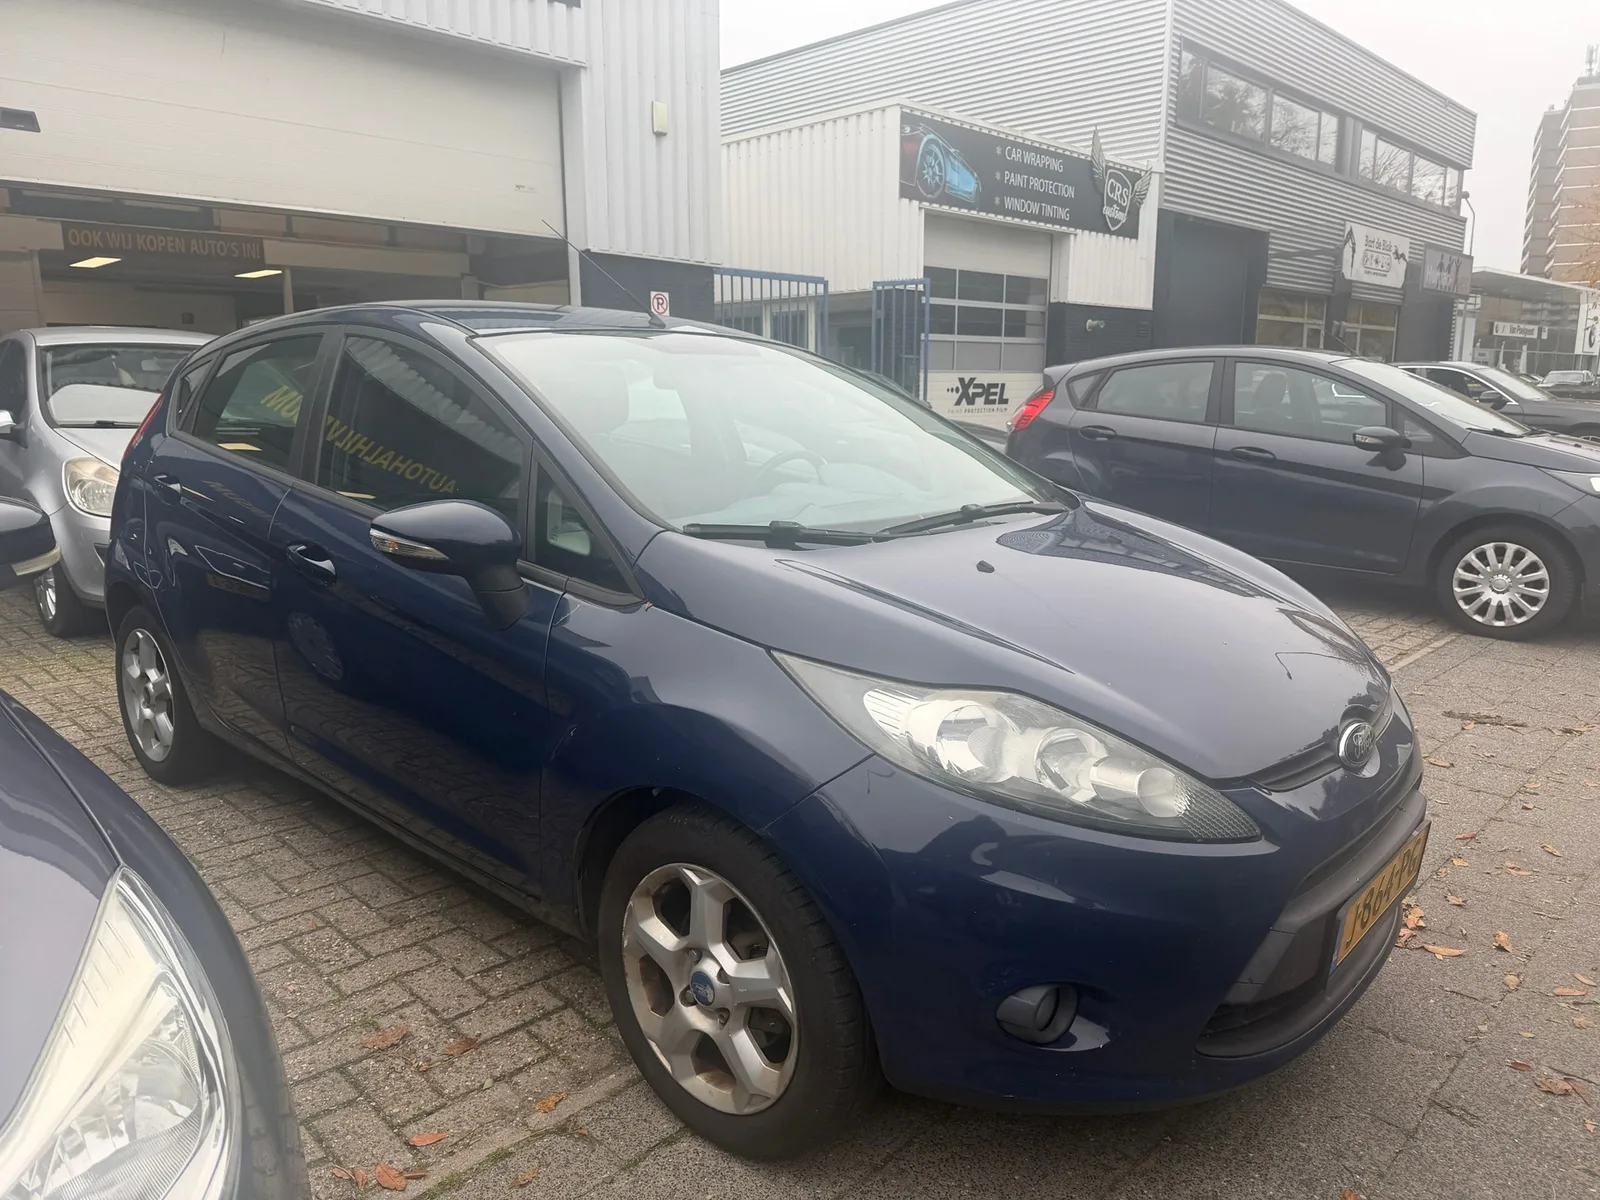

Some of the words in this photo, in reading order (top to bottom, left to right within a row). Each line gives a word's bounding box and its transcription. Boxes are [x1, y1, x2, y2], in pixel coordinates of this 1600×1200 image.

[1005, 146, 1022, 162] CAR
[1023, 150, 1063, 172] WRAPPING
[1004, 171, 1028, 189] PAINT
[1029, 174, 1075, 198] PROTECTION
[1107, 178, 1129, 206] CRS
[1004, 196, 1039, 216] WINDOW
[1040, 201, 1070, 221] TINTING
[68, 229, 104, 248] OOK
[106, 232, 132, 250] WIJ
[136, 234, 186, 253] KOPEN
[190, 238, 239, 257] AUTO'S
[954, 377, 1009, 406] XPEL
[1345, 837, 1422, 949] J-864-PG
